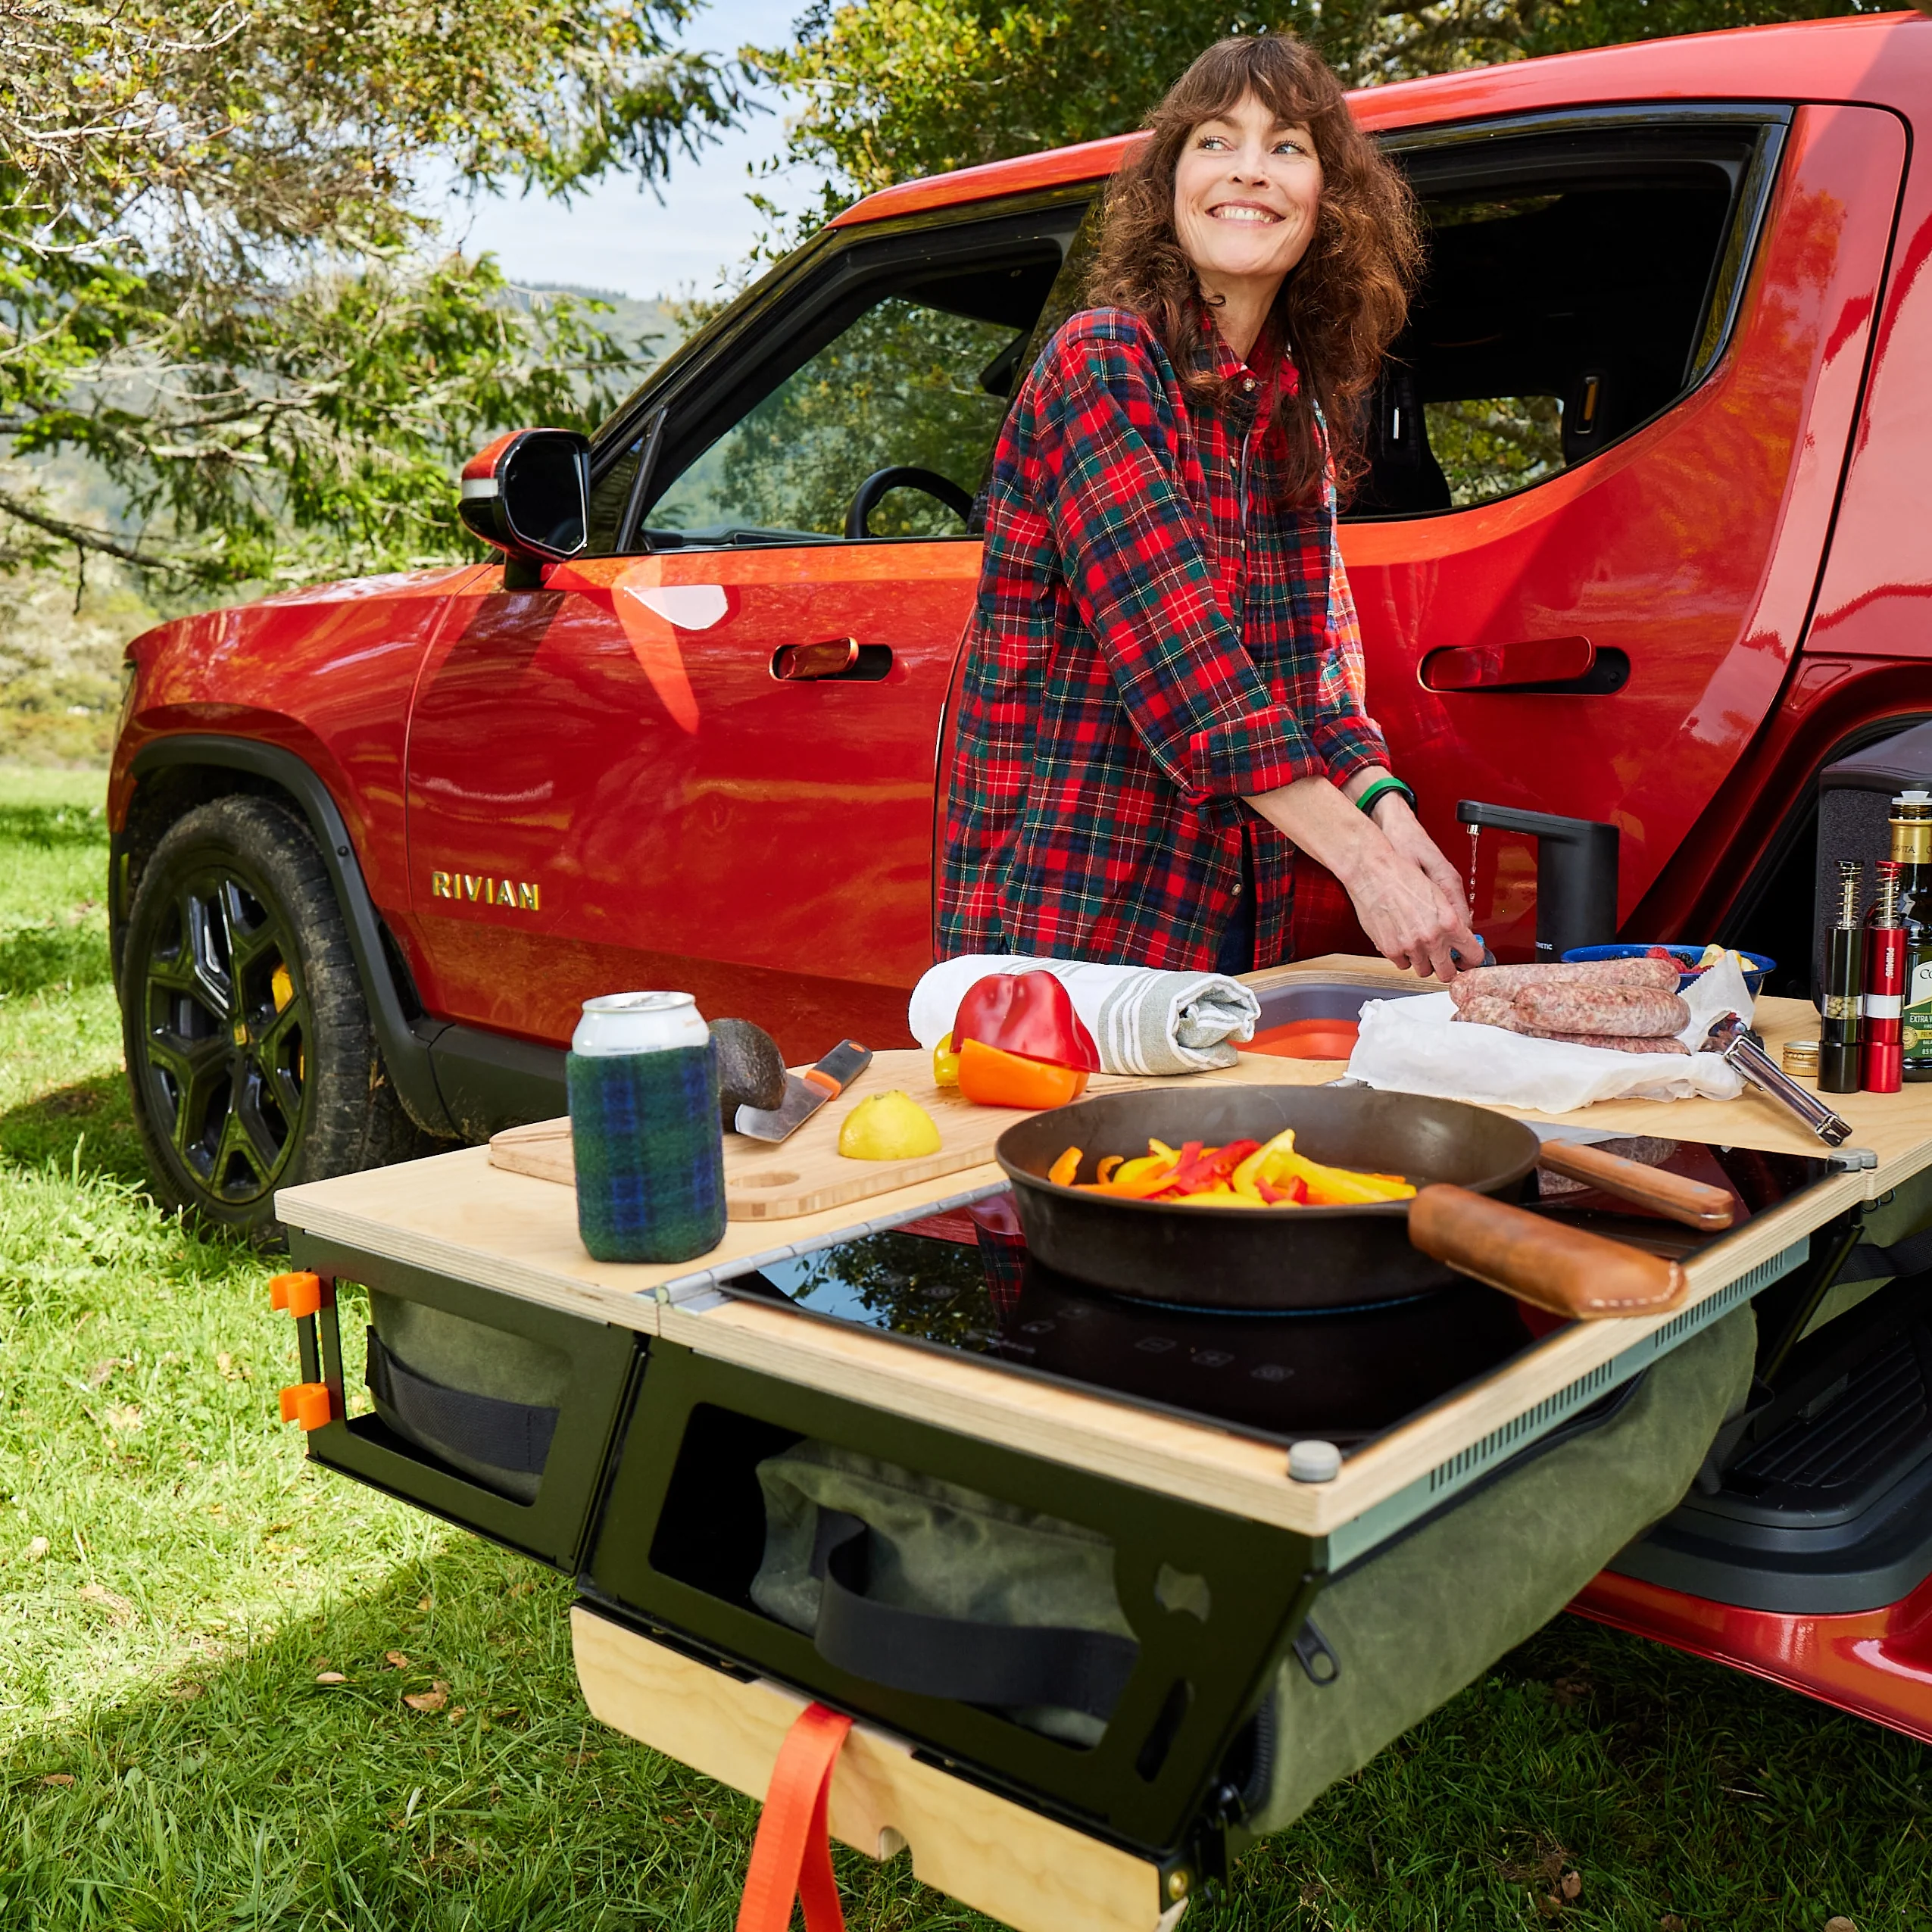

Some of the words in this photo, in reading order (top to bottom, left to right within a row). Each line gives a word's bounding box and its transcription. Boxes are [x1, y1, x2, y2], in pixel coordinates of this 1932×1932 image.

[432, 870, 540, 911] RIVIAN
[1885, 947, 1895, 978] PRIMUS
[1909, 1015, 1929, 1023] EXTRA
